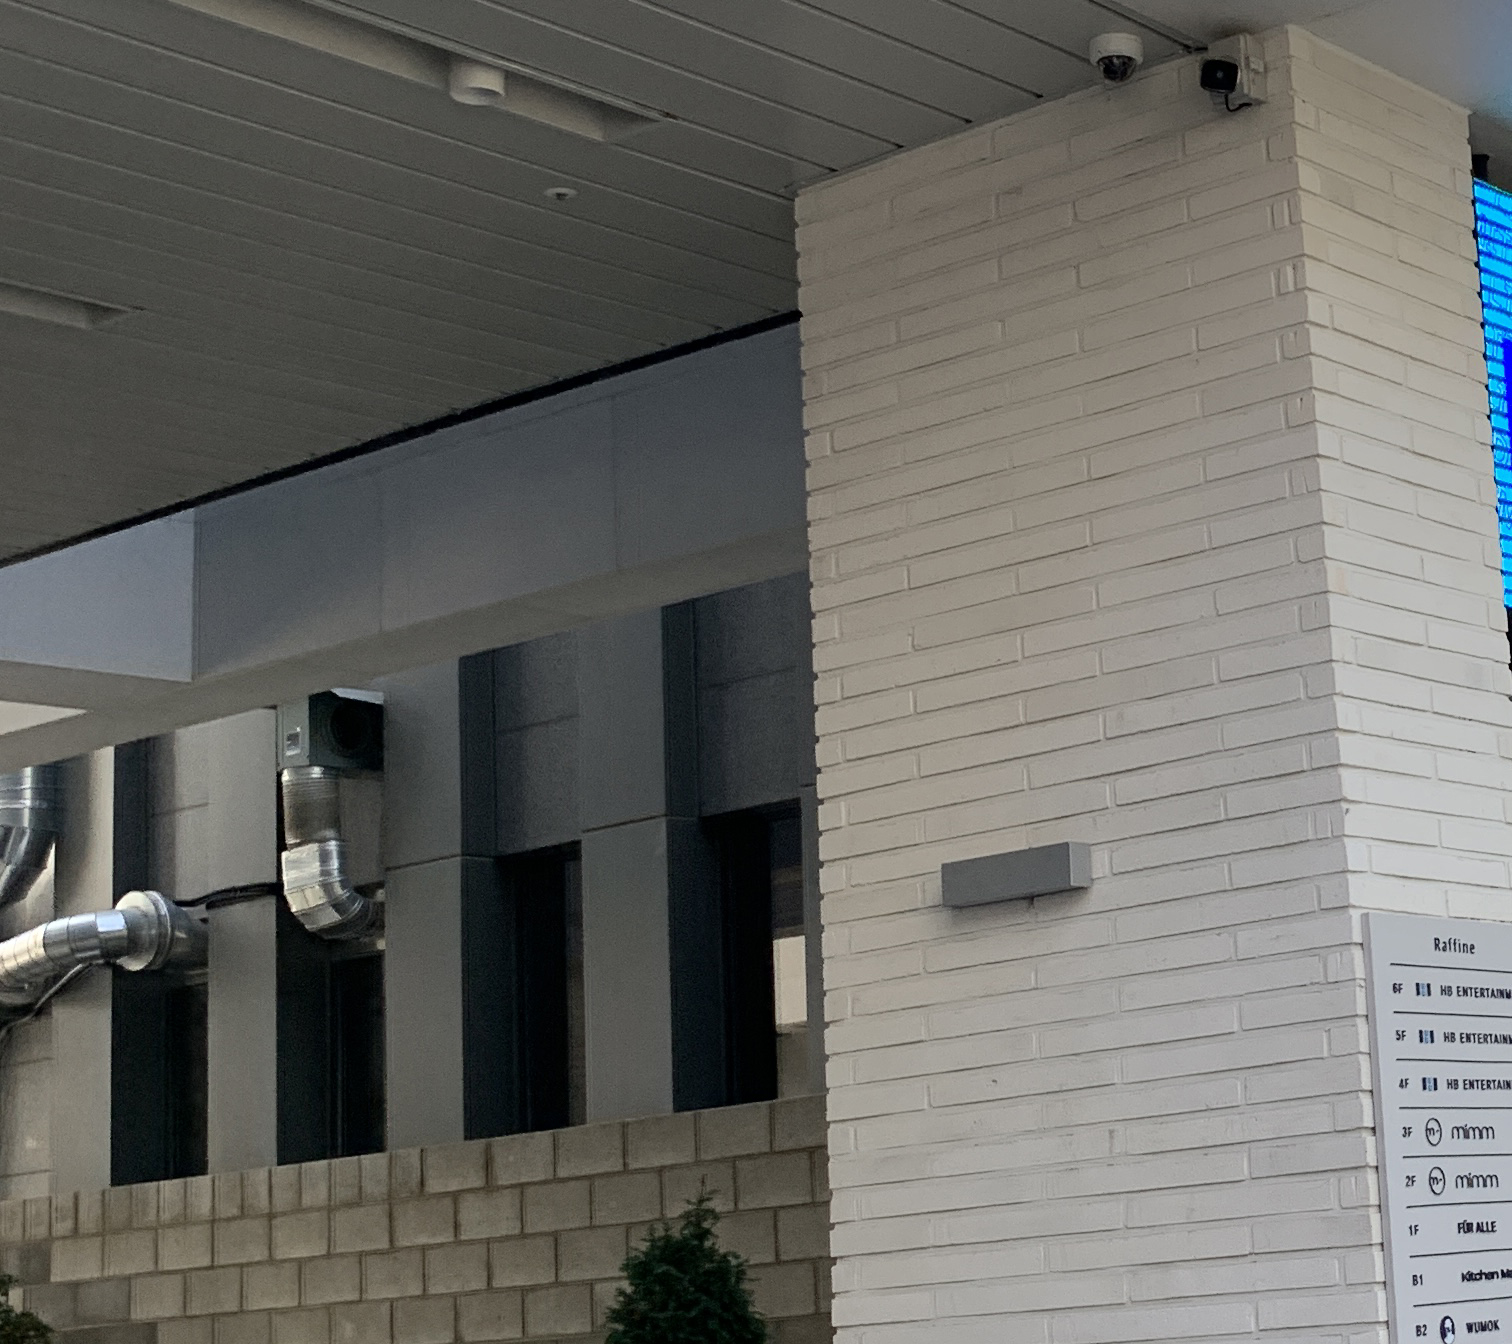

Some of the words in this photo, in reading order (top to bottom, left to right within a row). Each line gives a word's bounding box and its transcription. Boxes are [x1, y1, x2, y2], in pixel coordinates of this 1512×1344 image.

[1433, 937, 1476, 955] Raffine
[1392, 982, 1404, 994] 6F
[1440, 985, 1453, 997] HB
[1395, 1029, 1406, 1041] 5F
[1443, 1031, 1456, 1043] HB
[1398, 1078, 1409, 1089] 4F
[1446, 1079, 1459, 1090] HB
[1402, 1127, 1413, 1138] 3F
[1451, 1124, 1495, 1140] mimm
[1405, 1175, 1417, 1187] 2F
[1455, 1172, 1499, 1189] mimm
[1408, 1224, 1419, 1236] 1F
[1475, 1221, 1497, 1234] ALLE
[1412, 1274, 1424, 1286] B1
[1461, 1270, 1499, 1283] Kitchen
[1415, 1324, 1428, 1337] B2
[1465, 1319, 1500, 1334] WUMOK
